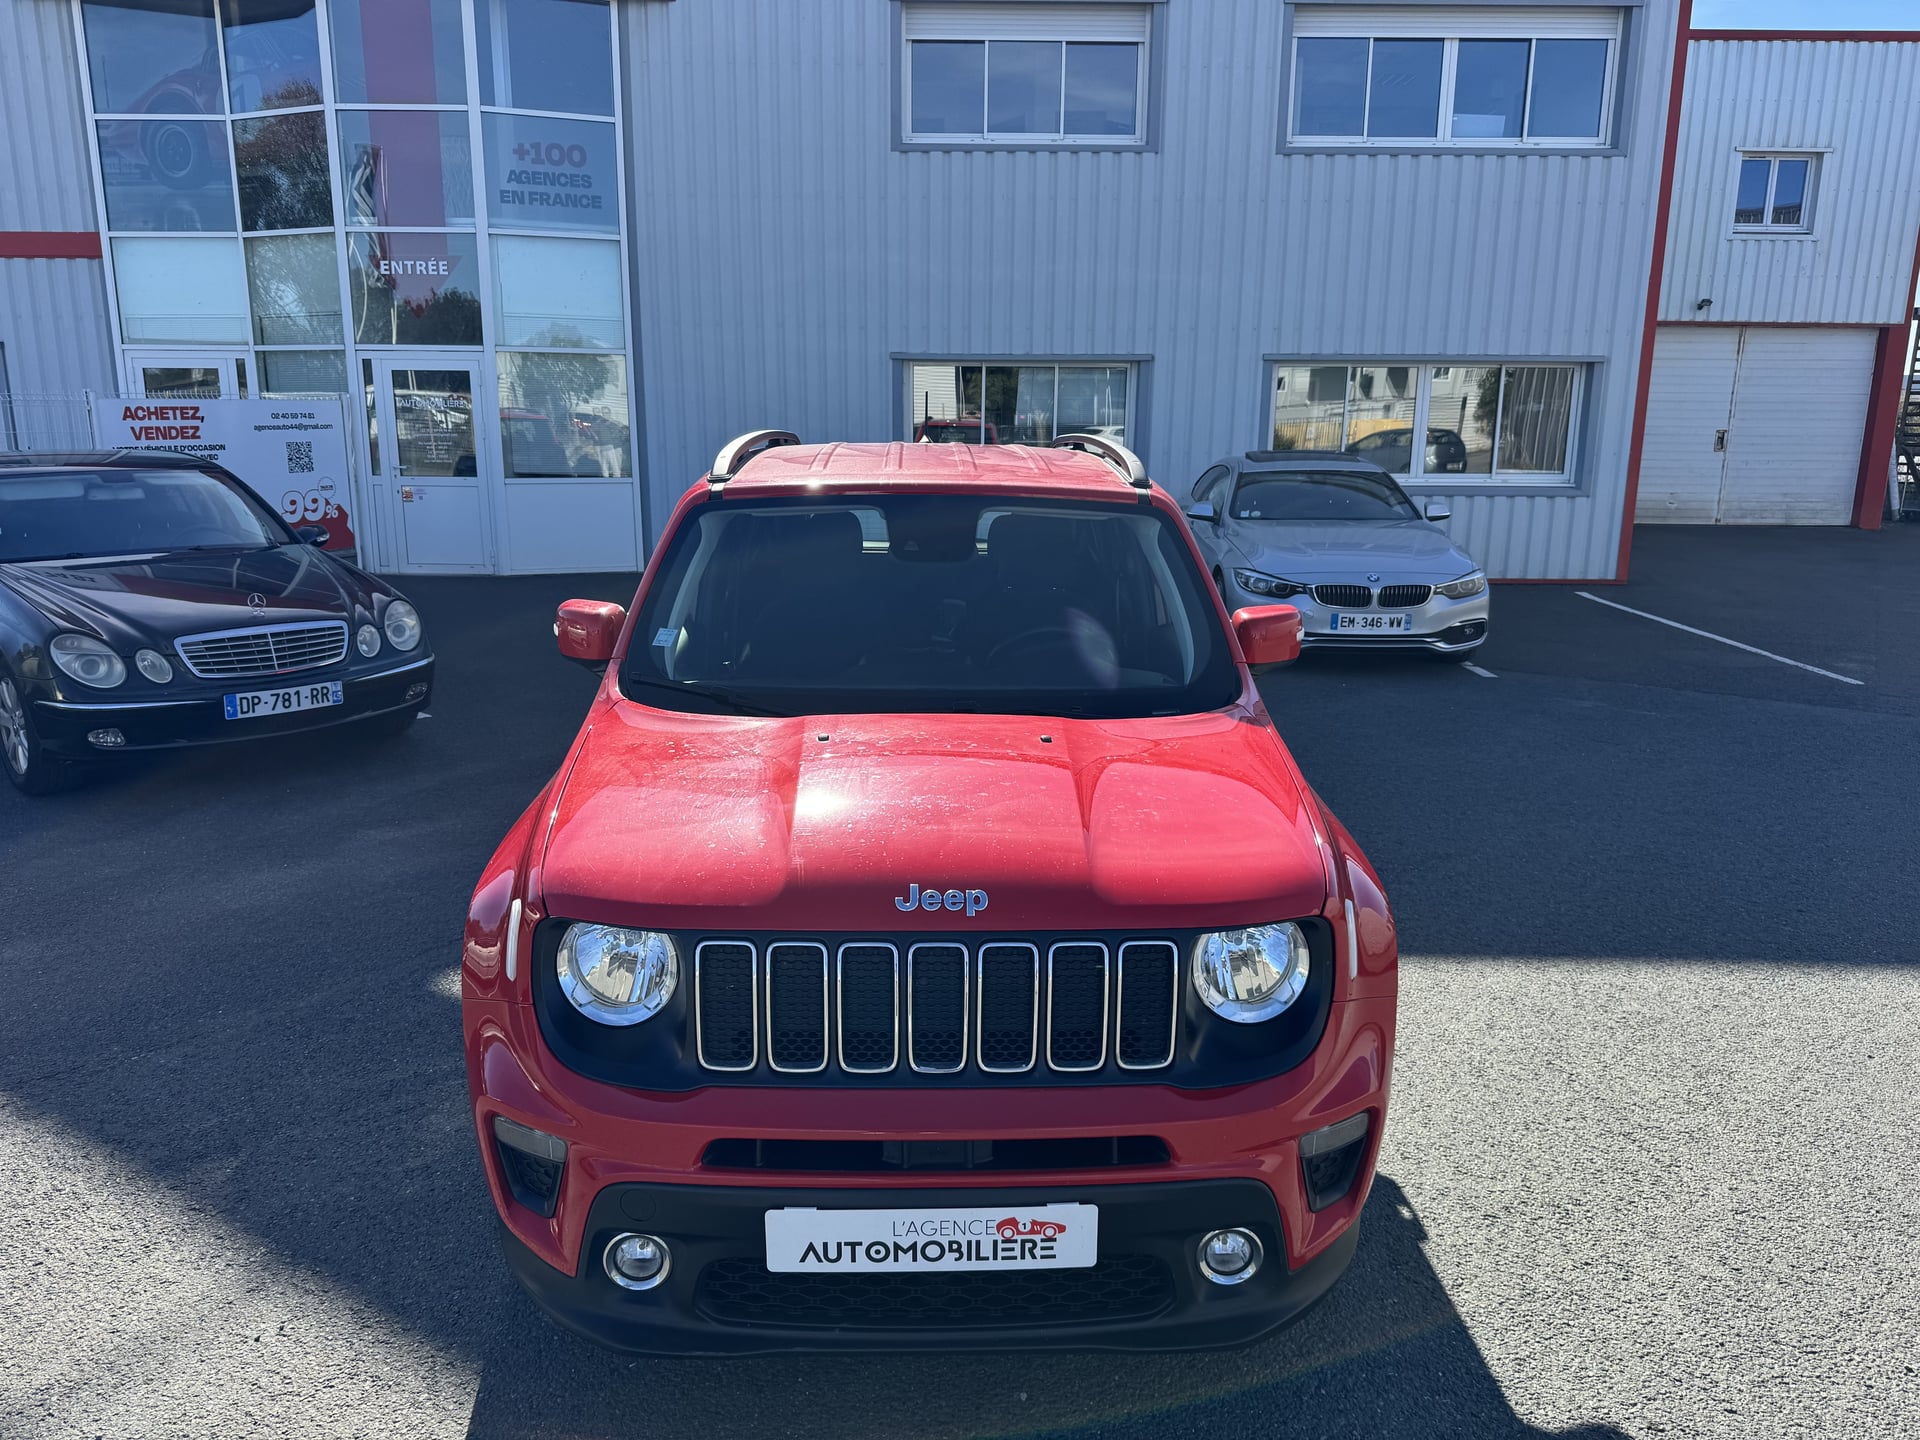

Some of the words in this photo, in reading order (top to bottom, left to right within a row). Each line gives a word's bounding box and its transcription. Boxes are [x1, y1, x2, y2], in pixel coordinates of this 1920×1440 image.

[512, 142, 587, 168] +100
[506, 169, 592, 189] AGENCES
[500, 190, 526, 205] EN
[528, 191, 602, 210] FRANCE
[380, 257, 449, 275] ENTRÉE
[122, 406, 205, 423] ACHETEZ,
[129, 425, 201, 441] VENDEZ
[180, 444, 226, 452] D'OCCASION
[239, 686, 331, 715] DP-781-RR
[894, 883, 989, 917] Jeep
[892, 1218, 996, 1237] L'AGENCE
